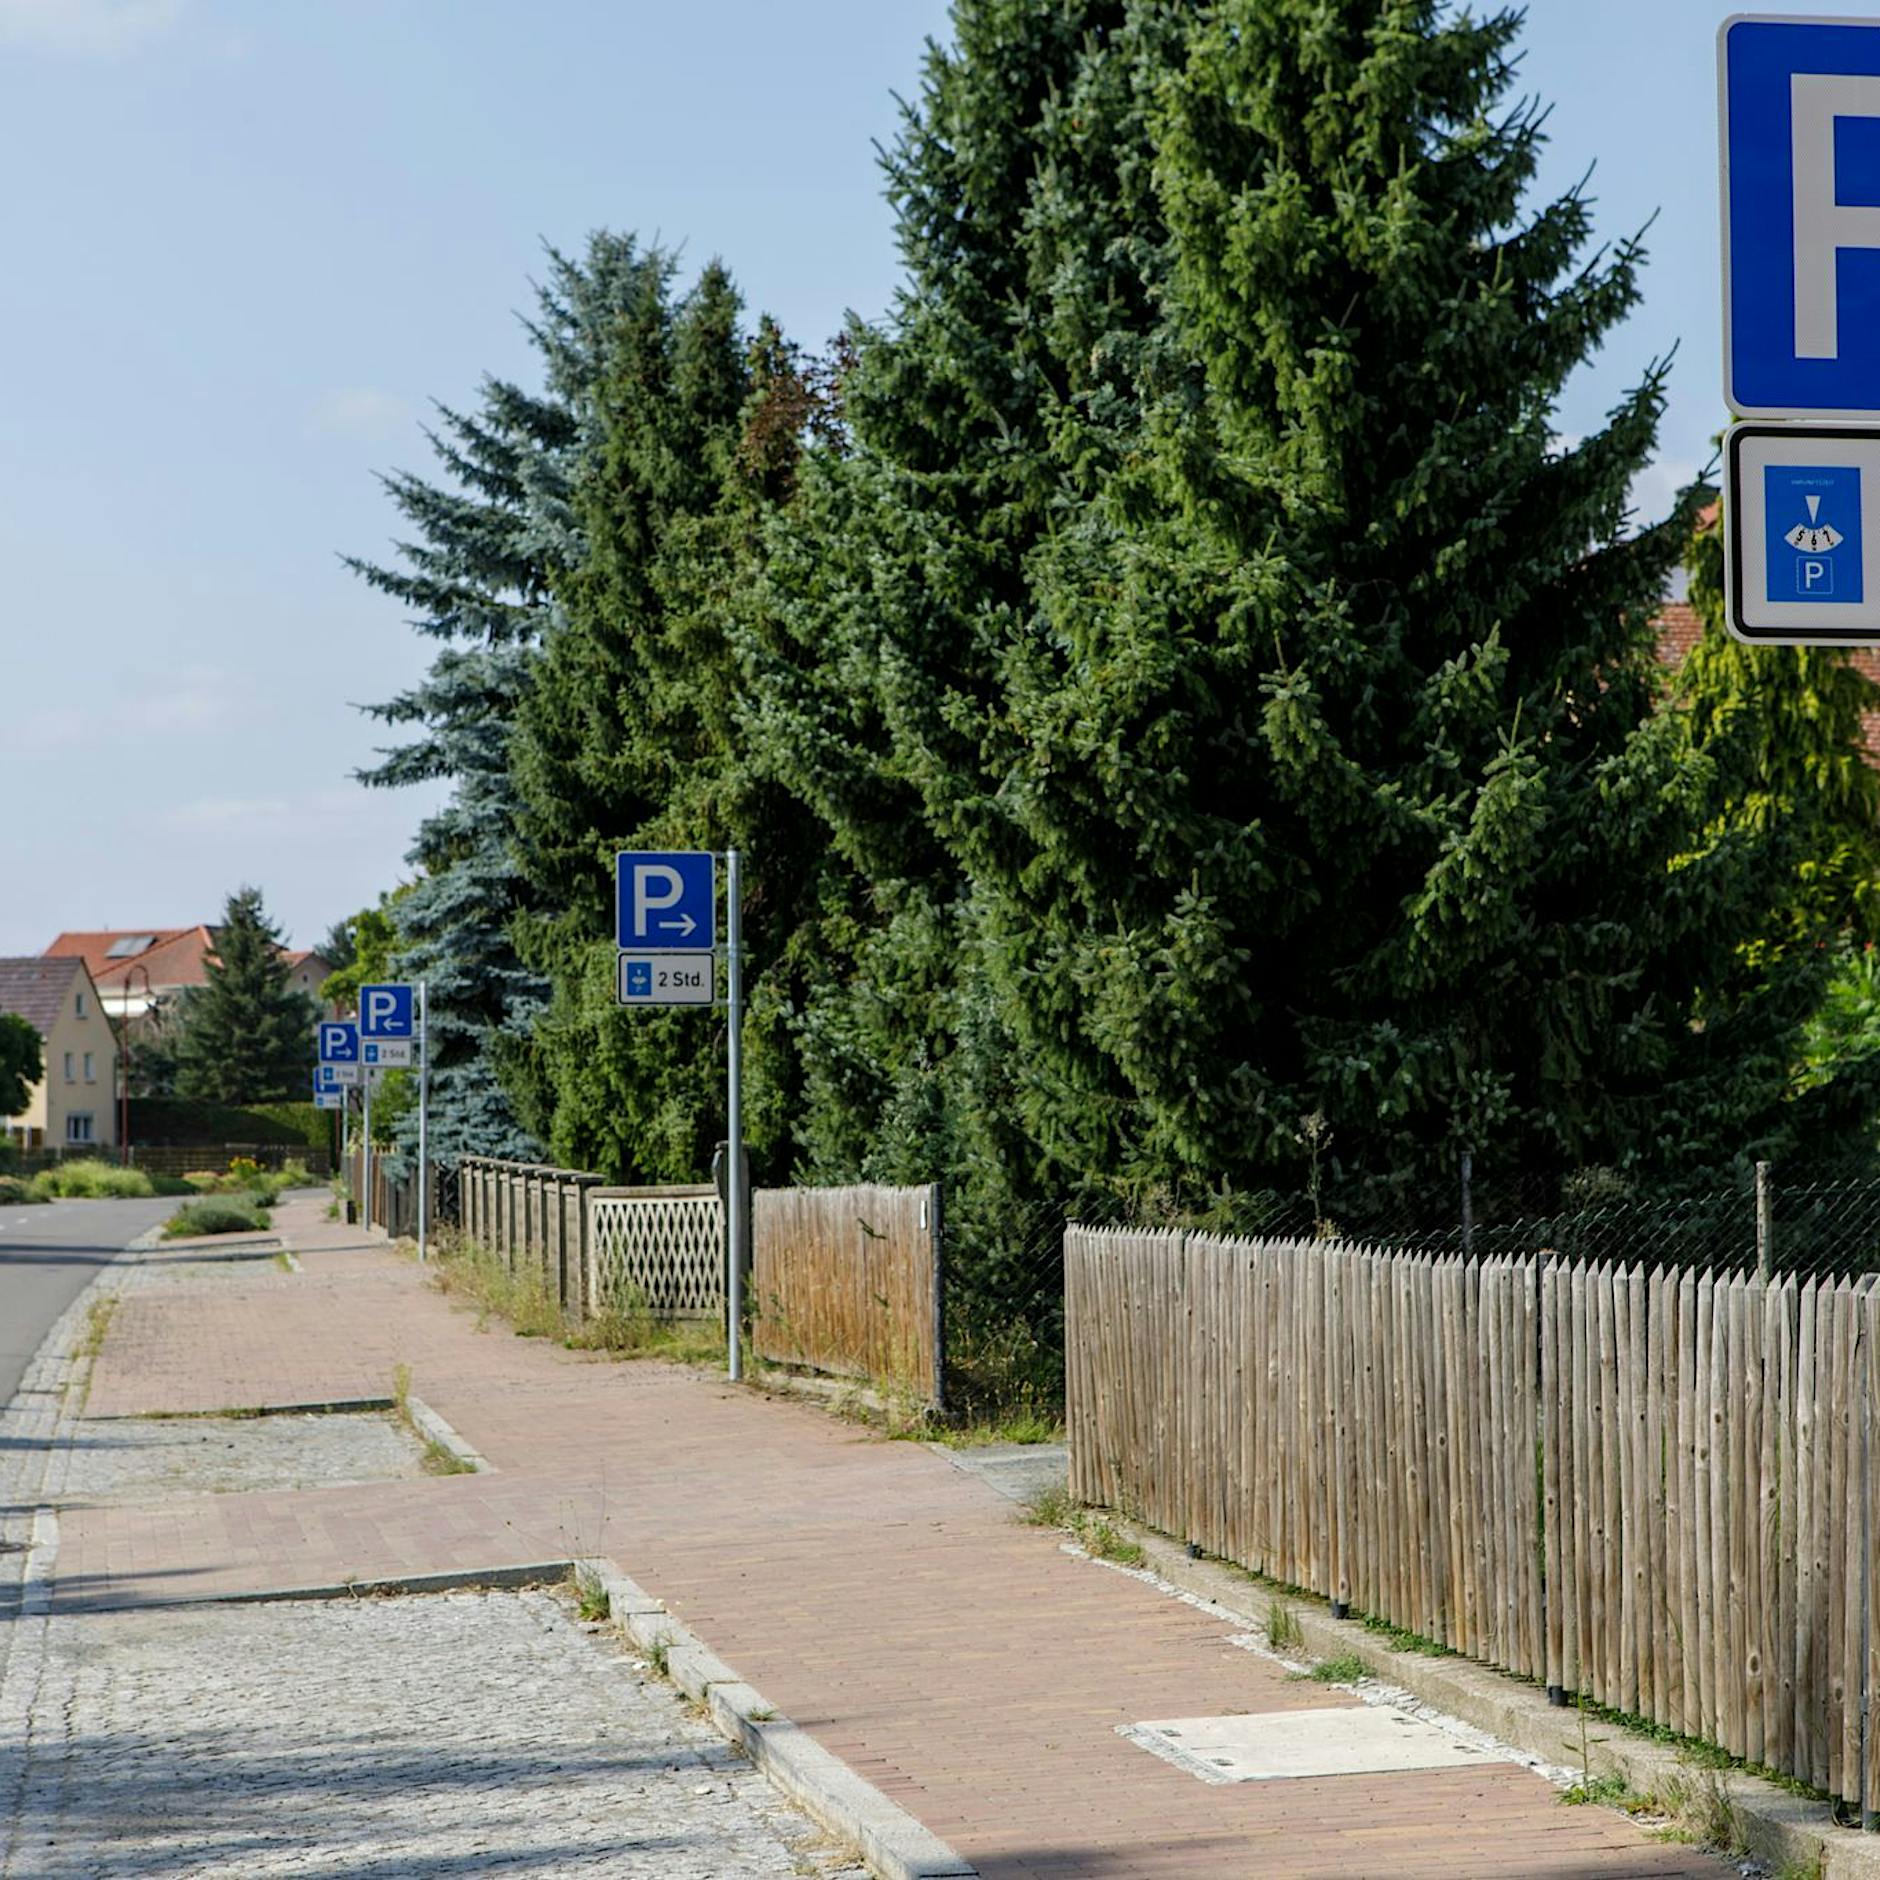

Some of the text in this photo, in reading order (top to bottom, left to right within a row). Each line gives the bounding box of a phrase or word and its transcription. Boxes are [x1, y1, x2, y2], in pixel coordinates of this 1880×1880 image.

[1805, 561, 1824, 589] P
[634, 864, 684, 937] P
[658, 971, 705, 987] 2 Std.
[369, 991, 397, 1031] P
[326, 1027, 347, 1058] P
